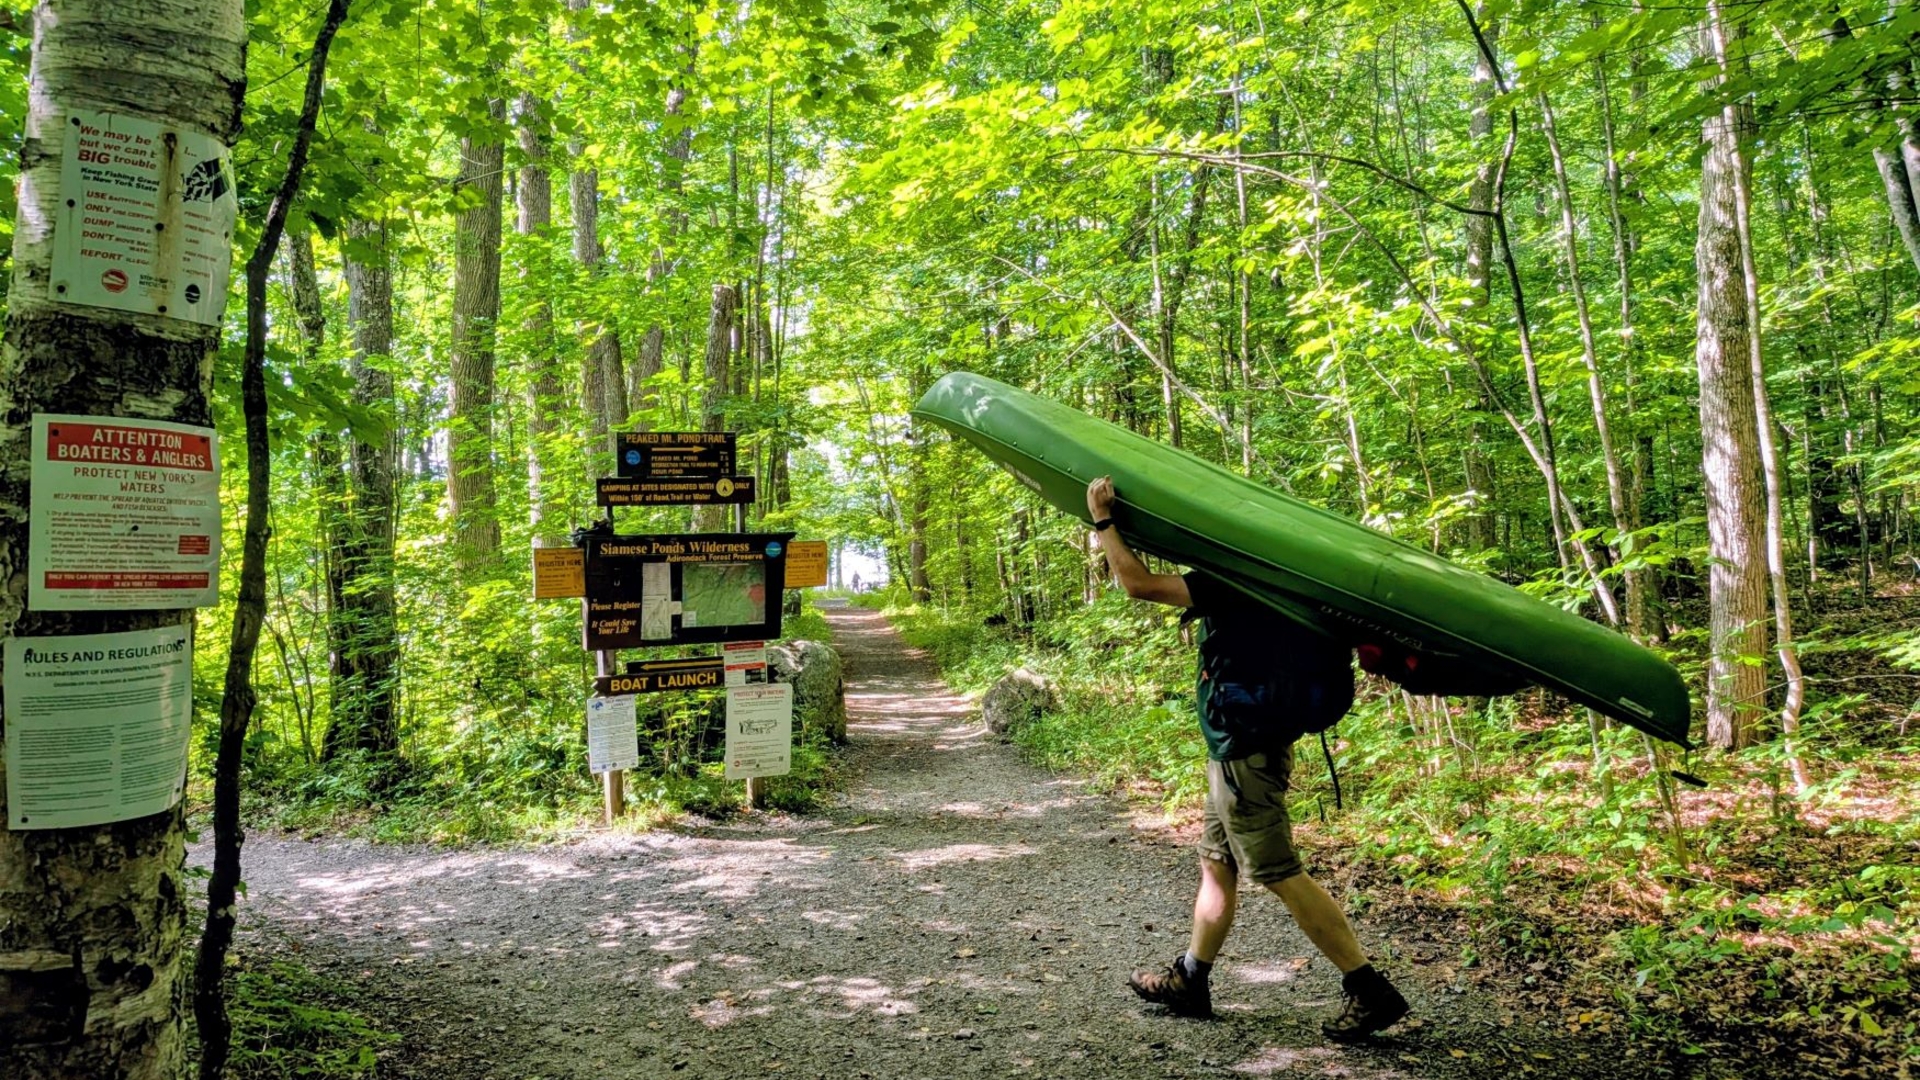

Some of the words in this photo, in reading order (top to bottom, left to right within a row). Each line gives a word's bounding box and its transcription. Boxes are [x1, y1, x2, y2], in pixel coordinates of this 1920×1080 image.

[80, 125, 100, 136] We
[103, 130, 132, 143] may
[135, 135, 152, 145] be
[80, 138, 100, 148] but
[103, 143, 121, 151] we
[77, 149, 111, 164] BIG
[113, 155, 157, 170] trouble
[81, 167, 103, 176] Keep
[105, 170, 136, 182] Fishing
[114, 179, 133, 187] York
[135, 183, 158, 192] State
[86, 190, 107, 200] USE
[85, 203, 112, 213] ONLY
[84, 217, 114, 227] DUMP
[82, 230, 115, 241] DON'T
[80, 248, 124, 260] REPORT
[92, 428, 183, 449] ATTENTION
[626, 434, 659, 443] PEAKED
[677, 434, 701, 443] POND
[702, 433, 727, 443] TRAIL
[58, 444, 131, 462] BOATERS
[136, 449, 147, 463] &
[151, 450, 206, 468] ANGLERS
[74, 467, 130, 480] PROTECT
[134, 470, 157, 481] NEW
[161, 472, 196, 485] YORK'S
[120, 482, 166, 494] WATERS
[601, 484, 631, 492] CAMPING
[660, 483, 697, 491] DESIGNATED
[608, 494, 630, 502] Within
[670, 493, 684, 501] Trail
[600, 542, 647, 555] Siamese
[652, 542, 685, 553] Ponds
[689, 541, 750, 552] Wilderness
[666, 554, 707, 563] Adirondack
[709, 553, 731, 561] Forest
[733, 553, 763, 561] Preserve
[613, 601, 641, 610] Register
[23, 650, 69, 664] RULES
[71, 650, 104, 662] AND
[109, 642, 184, 660] REGULATIONS
[610, 677, 648, 692] BOAT
[657, 672, 717, 688] LAUNCH
